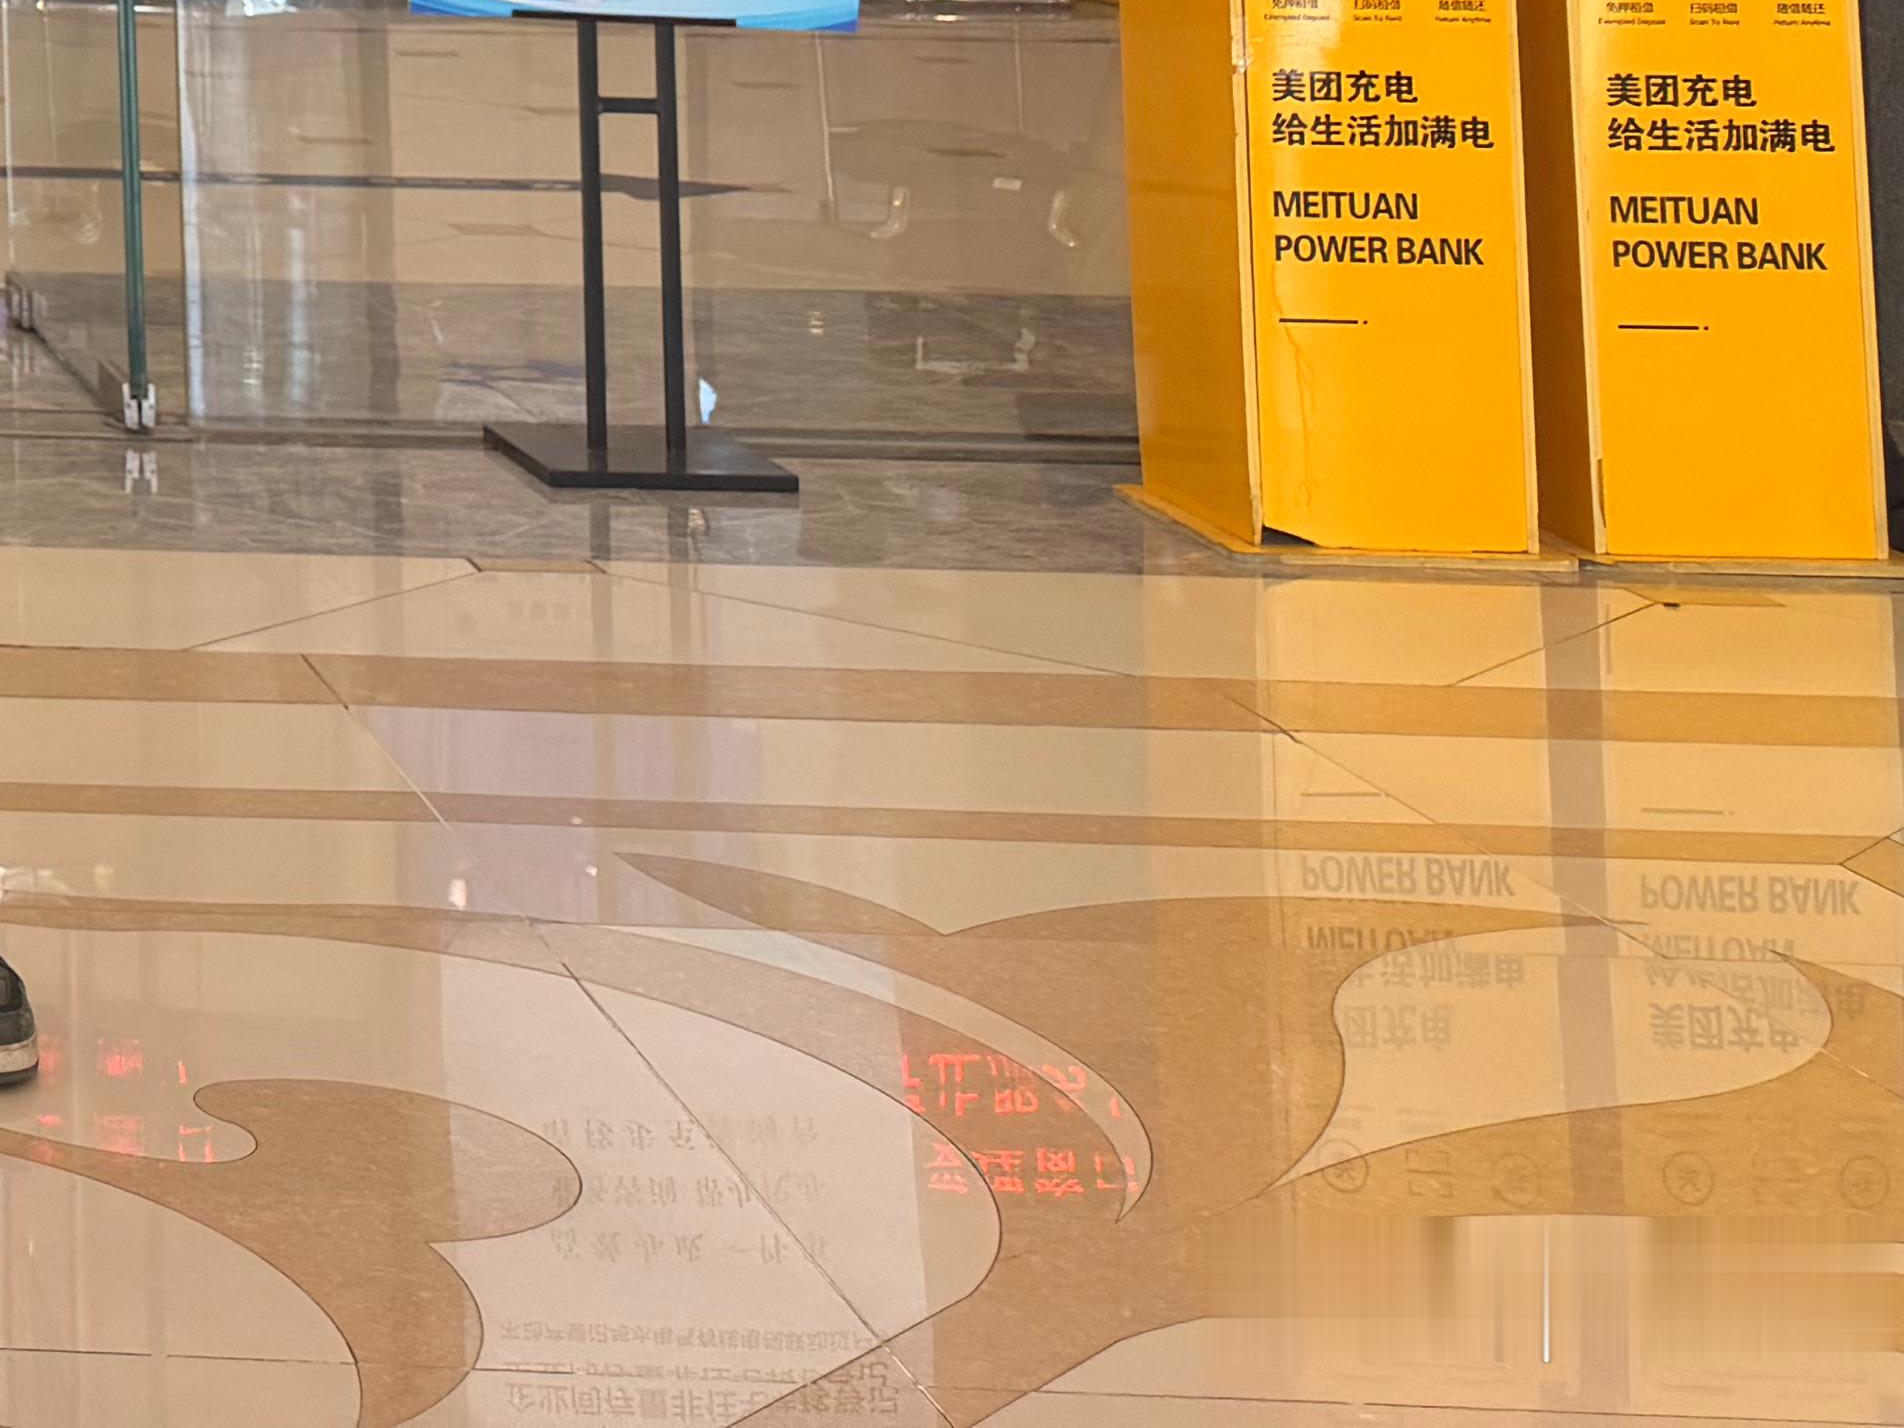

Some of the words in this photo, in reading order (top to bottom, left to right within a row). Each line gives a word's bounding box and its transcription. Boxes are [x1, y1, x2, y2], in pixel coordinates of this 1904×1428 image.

[1271, 68, 1419, 105] 美团充电
[1606, 73, 1758, 110] 美团充电
[1272, 113, 1496, 150] 给生活加满电
[1607, 117, 1837, 154] 给生活加满电
[1274, 190, 1419, 221] MEITUAN
[1610, 195, 1760, 226] MEITUAN
[1274, 234, 1388, 265] POWER
[1397, 236, 1485, 266] BANK
[1612, 240, 1729, 271] POWER
[1737, 241, 1828, 271] BANK
